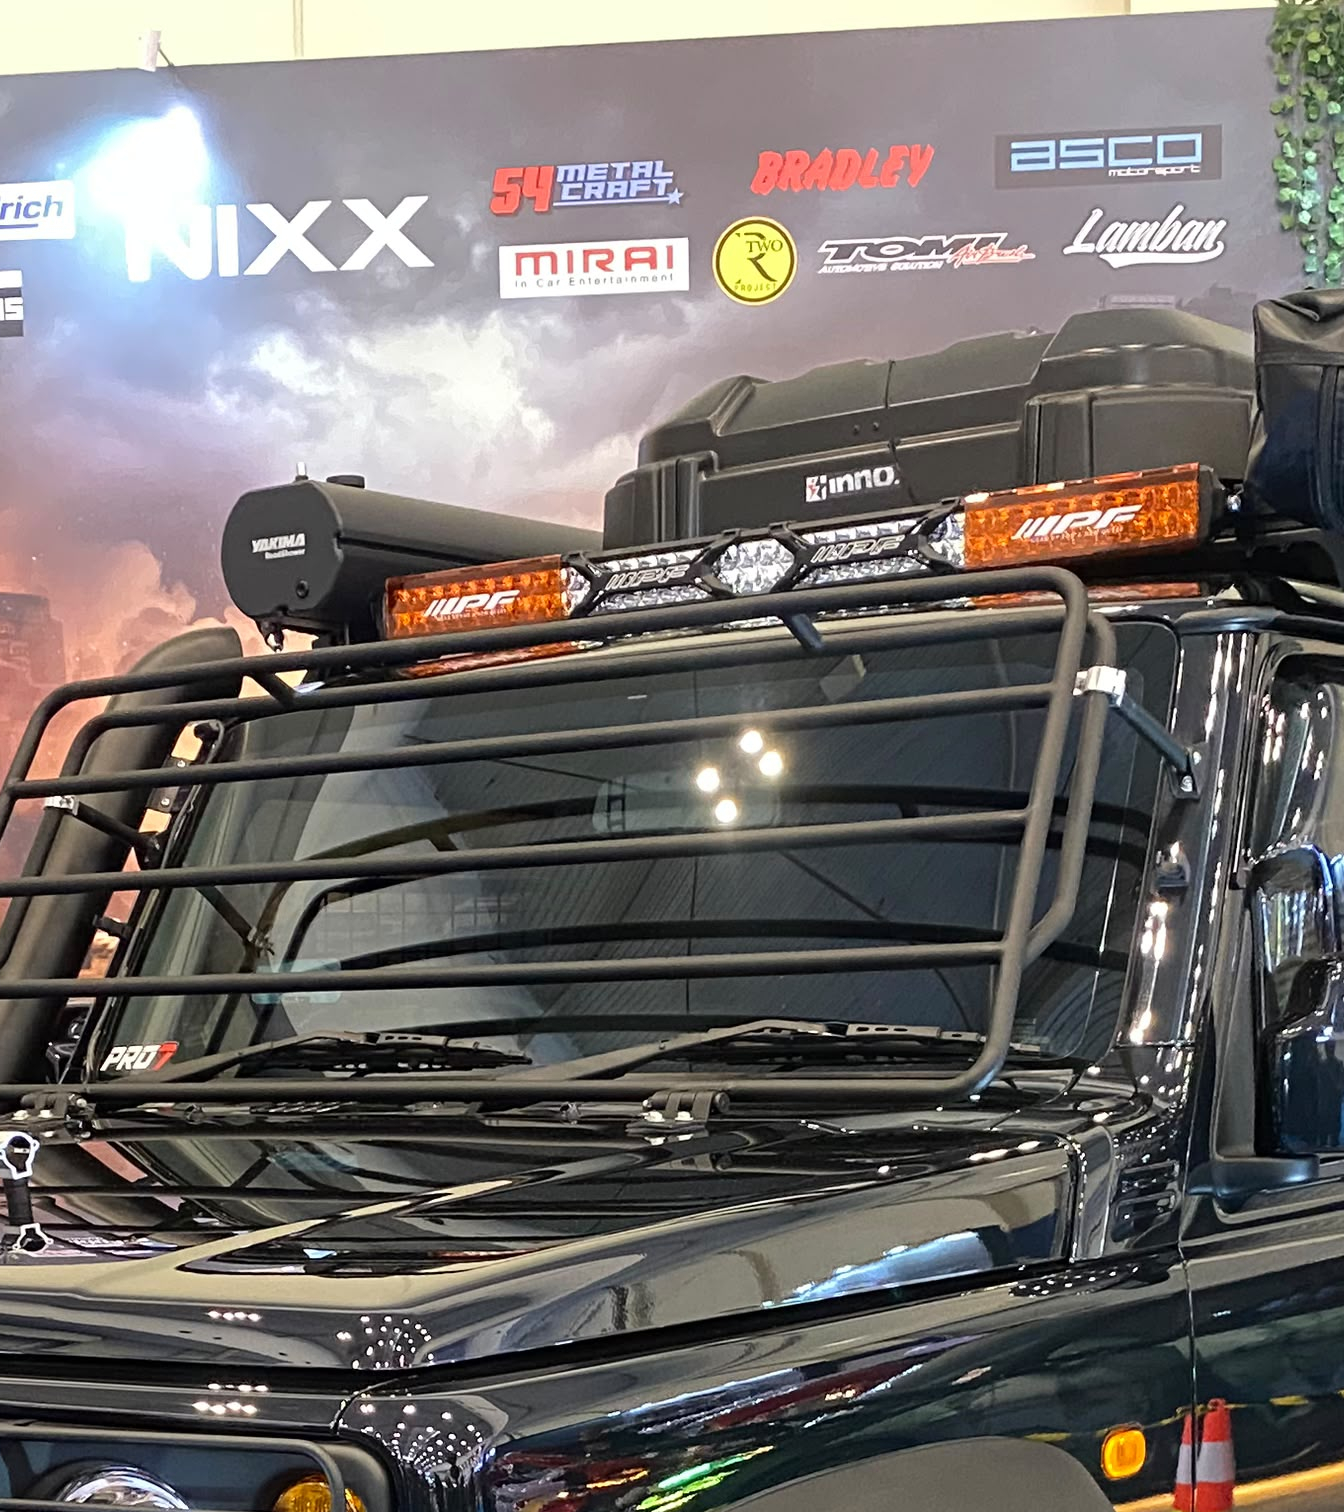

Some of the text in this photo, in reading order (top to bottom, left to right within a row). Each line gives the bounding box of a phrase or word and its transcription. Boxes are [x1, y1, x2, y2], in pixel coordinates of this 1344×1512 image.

[557, 159, 673, 182] METAL
[750, 143, 935, 195] BRADLEY
[1108, 163, 1201, 178] motorsport
[490, 165, 554, 214] 54
[560, 179, 672, 201] CRAFT
[125, 194, 436, 283] NIXX
[745, 239, 783, 253] TWO
[818, 232, 1009, 264] TOMI
[1062, 204, 1228, 268] Lamban
[515, 245, 674, 277] MIRAI
[536, 278, 561, 289] Car
[569, 273, 674, 288] Entertainment
[734, 282, 778, 292] PROJECT
[252, 533, 306, 553] YAKIMA
[100, 1041, 179, 1072] PRO7
